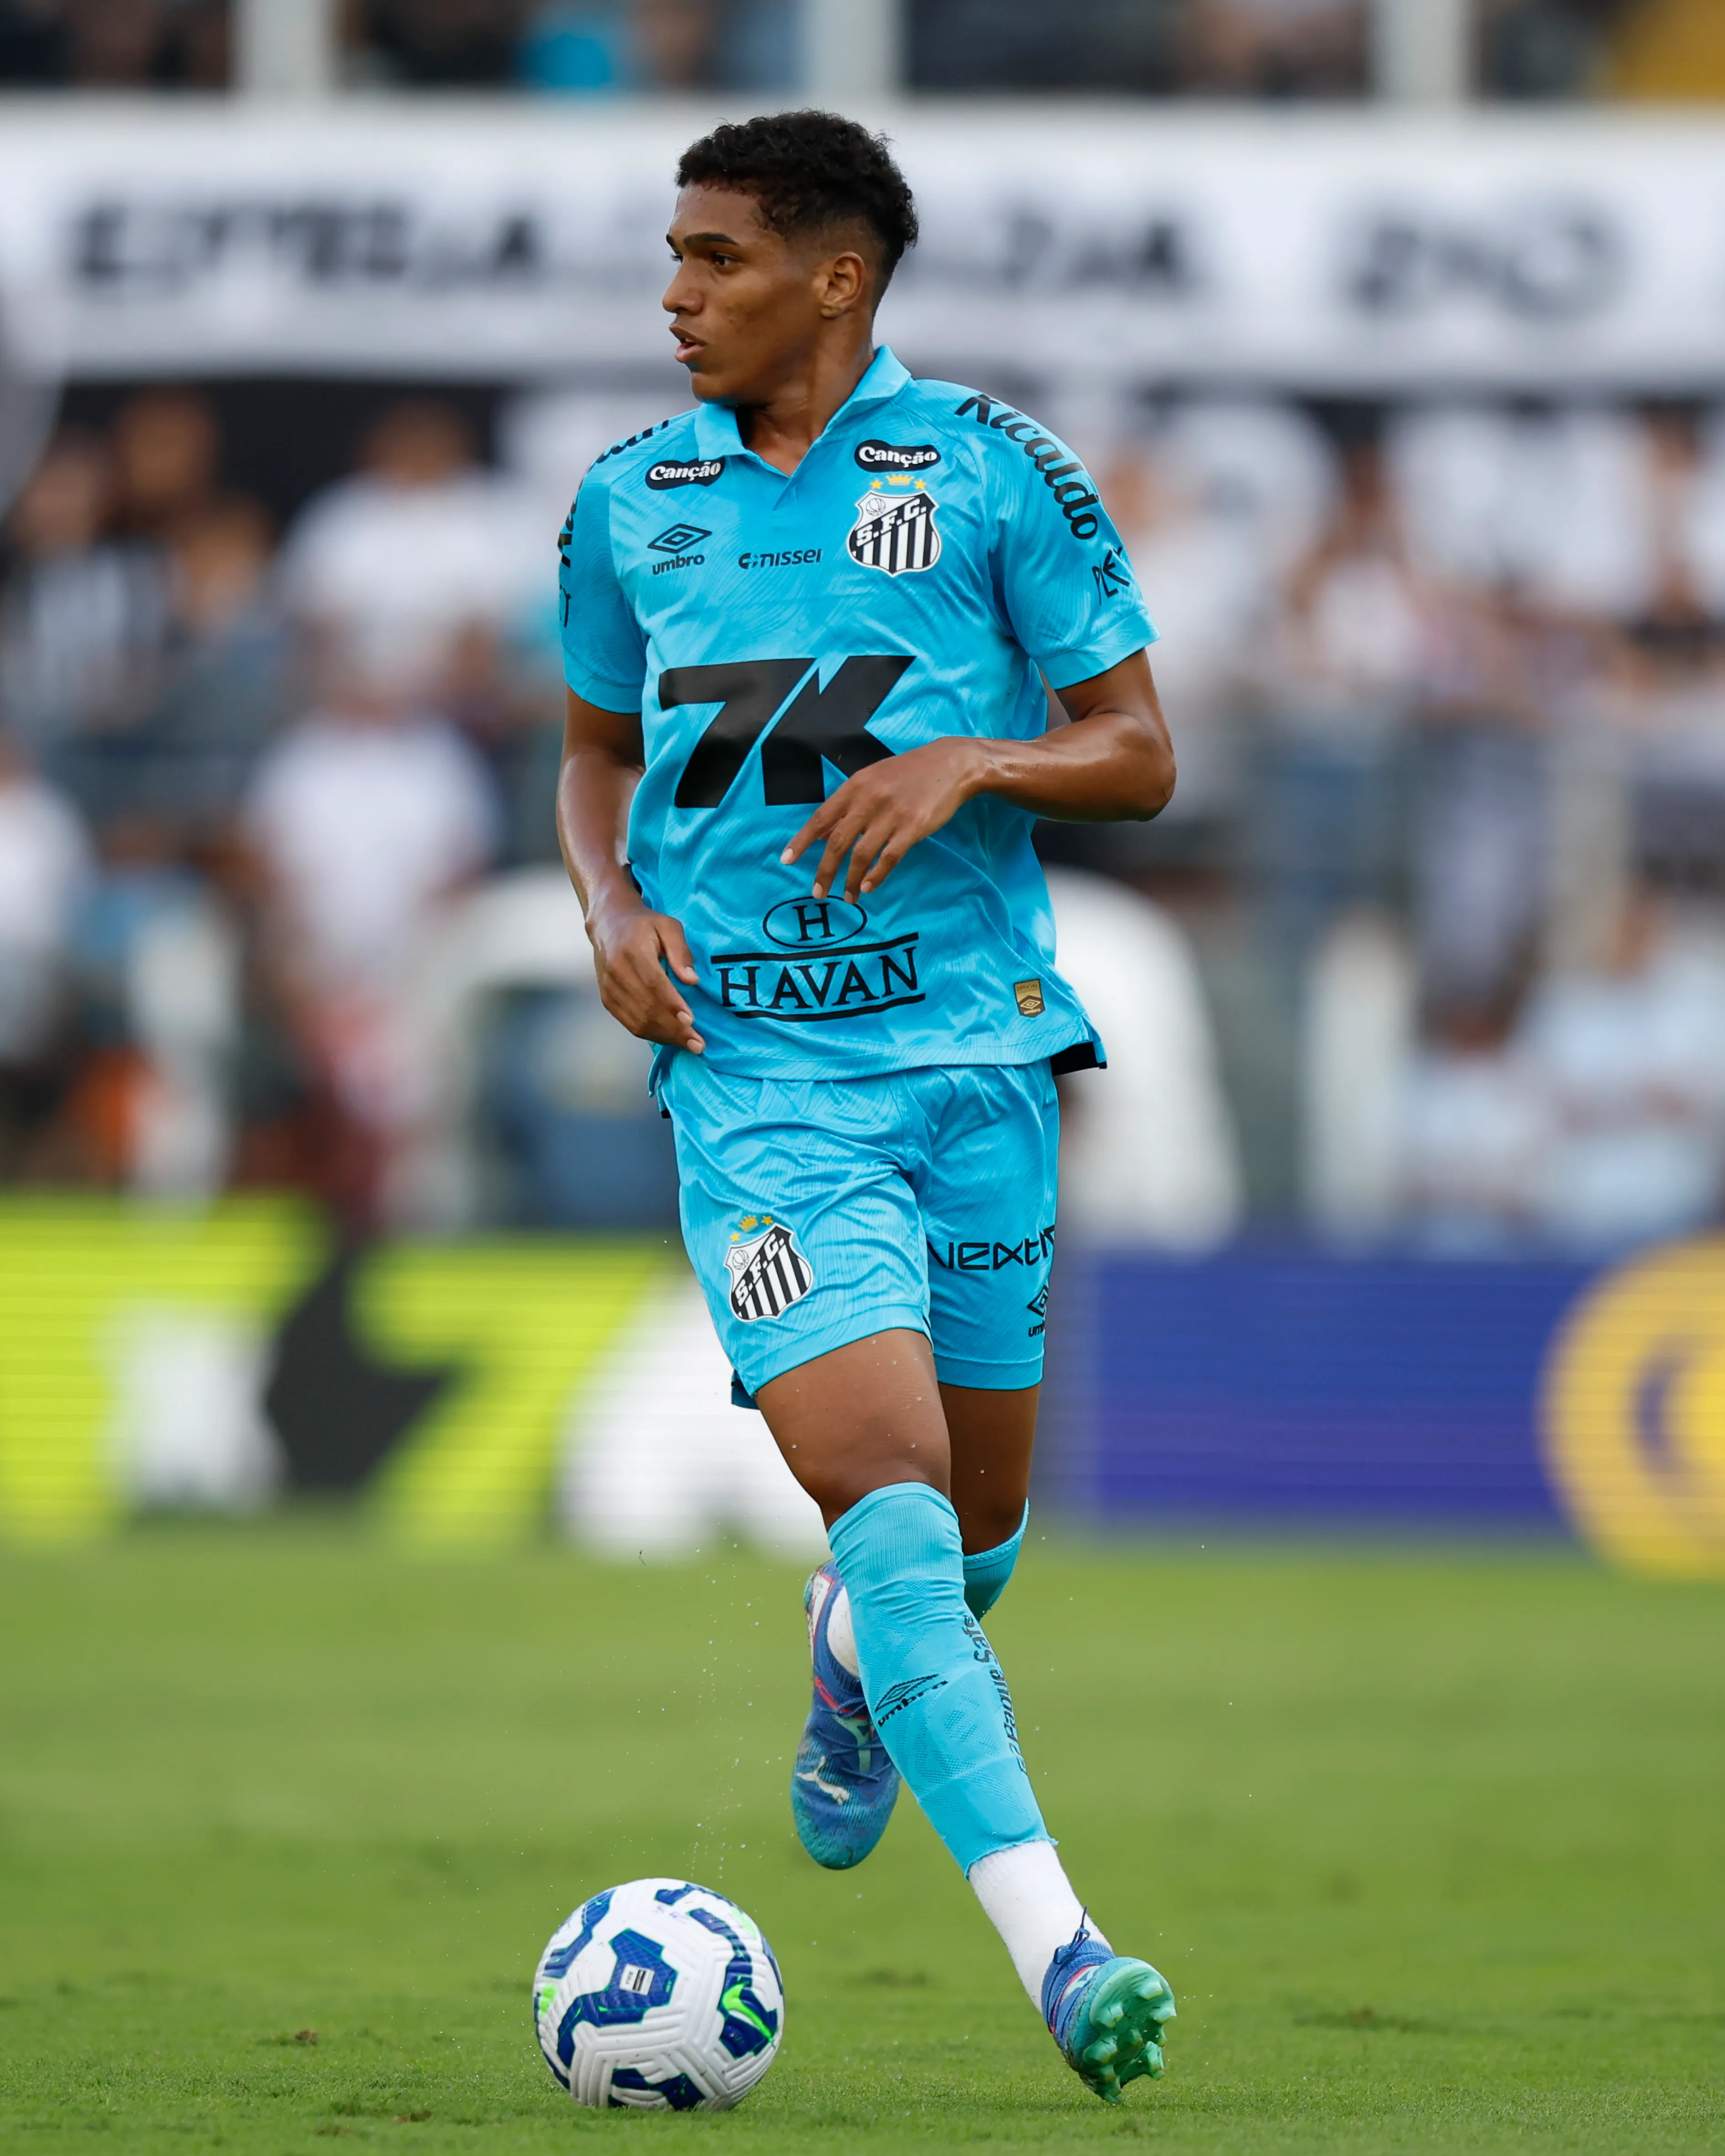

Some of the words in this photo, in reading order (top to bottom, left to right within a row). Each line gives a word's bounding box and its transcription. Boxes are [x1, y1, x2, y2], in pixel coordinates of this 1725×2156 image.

[650, 461, 721, 481] Canção
[859, 446, 938, 467] Canção
[856, 498, 927, 547] S.F.C.
[652, 554, 705, 575] umbro
[658, 655, 916, 808] 7K
[792, 902, 835, 942] H
[715, 946, 918, 1009] HAVAN
